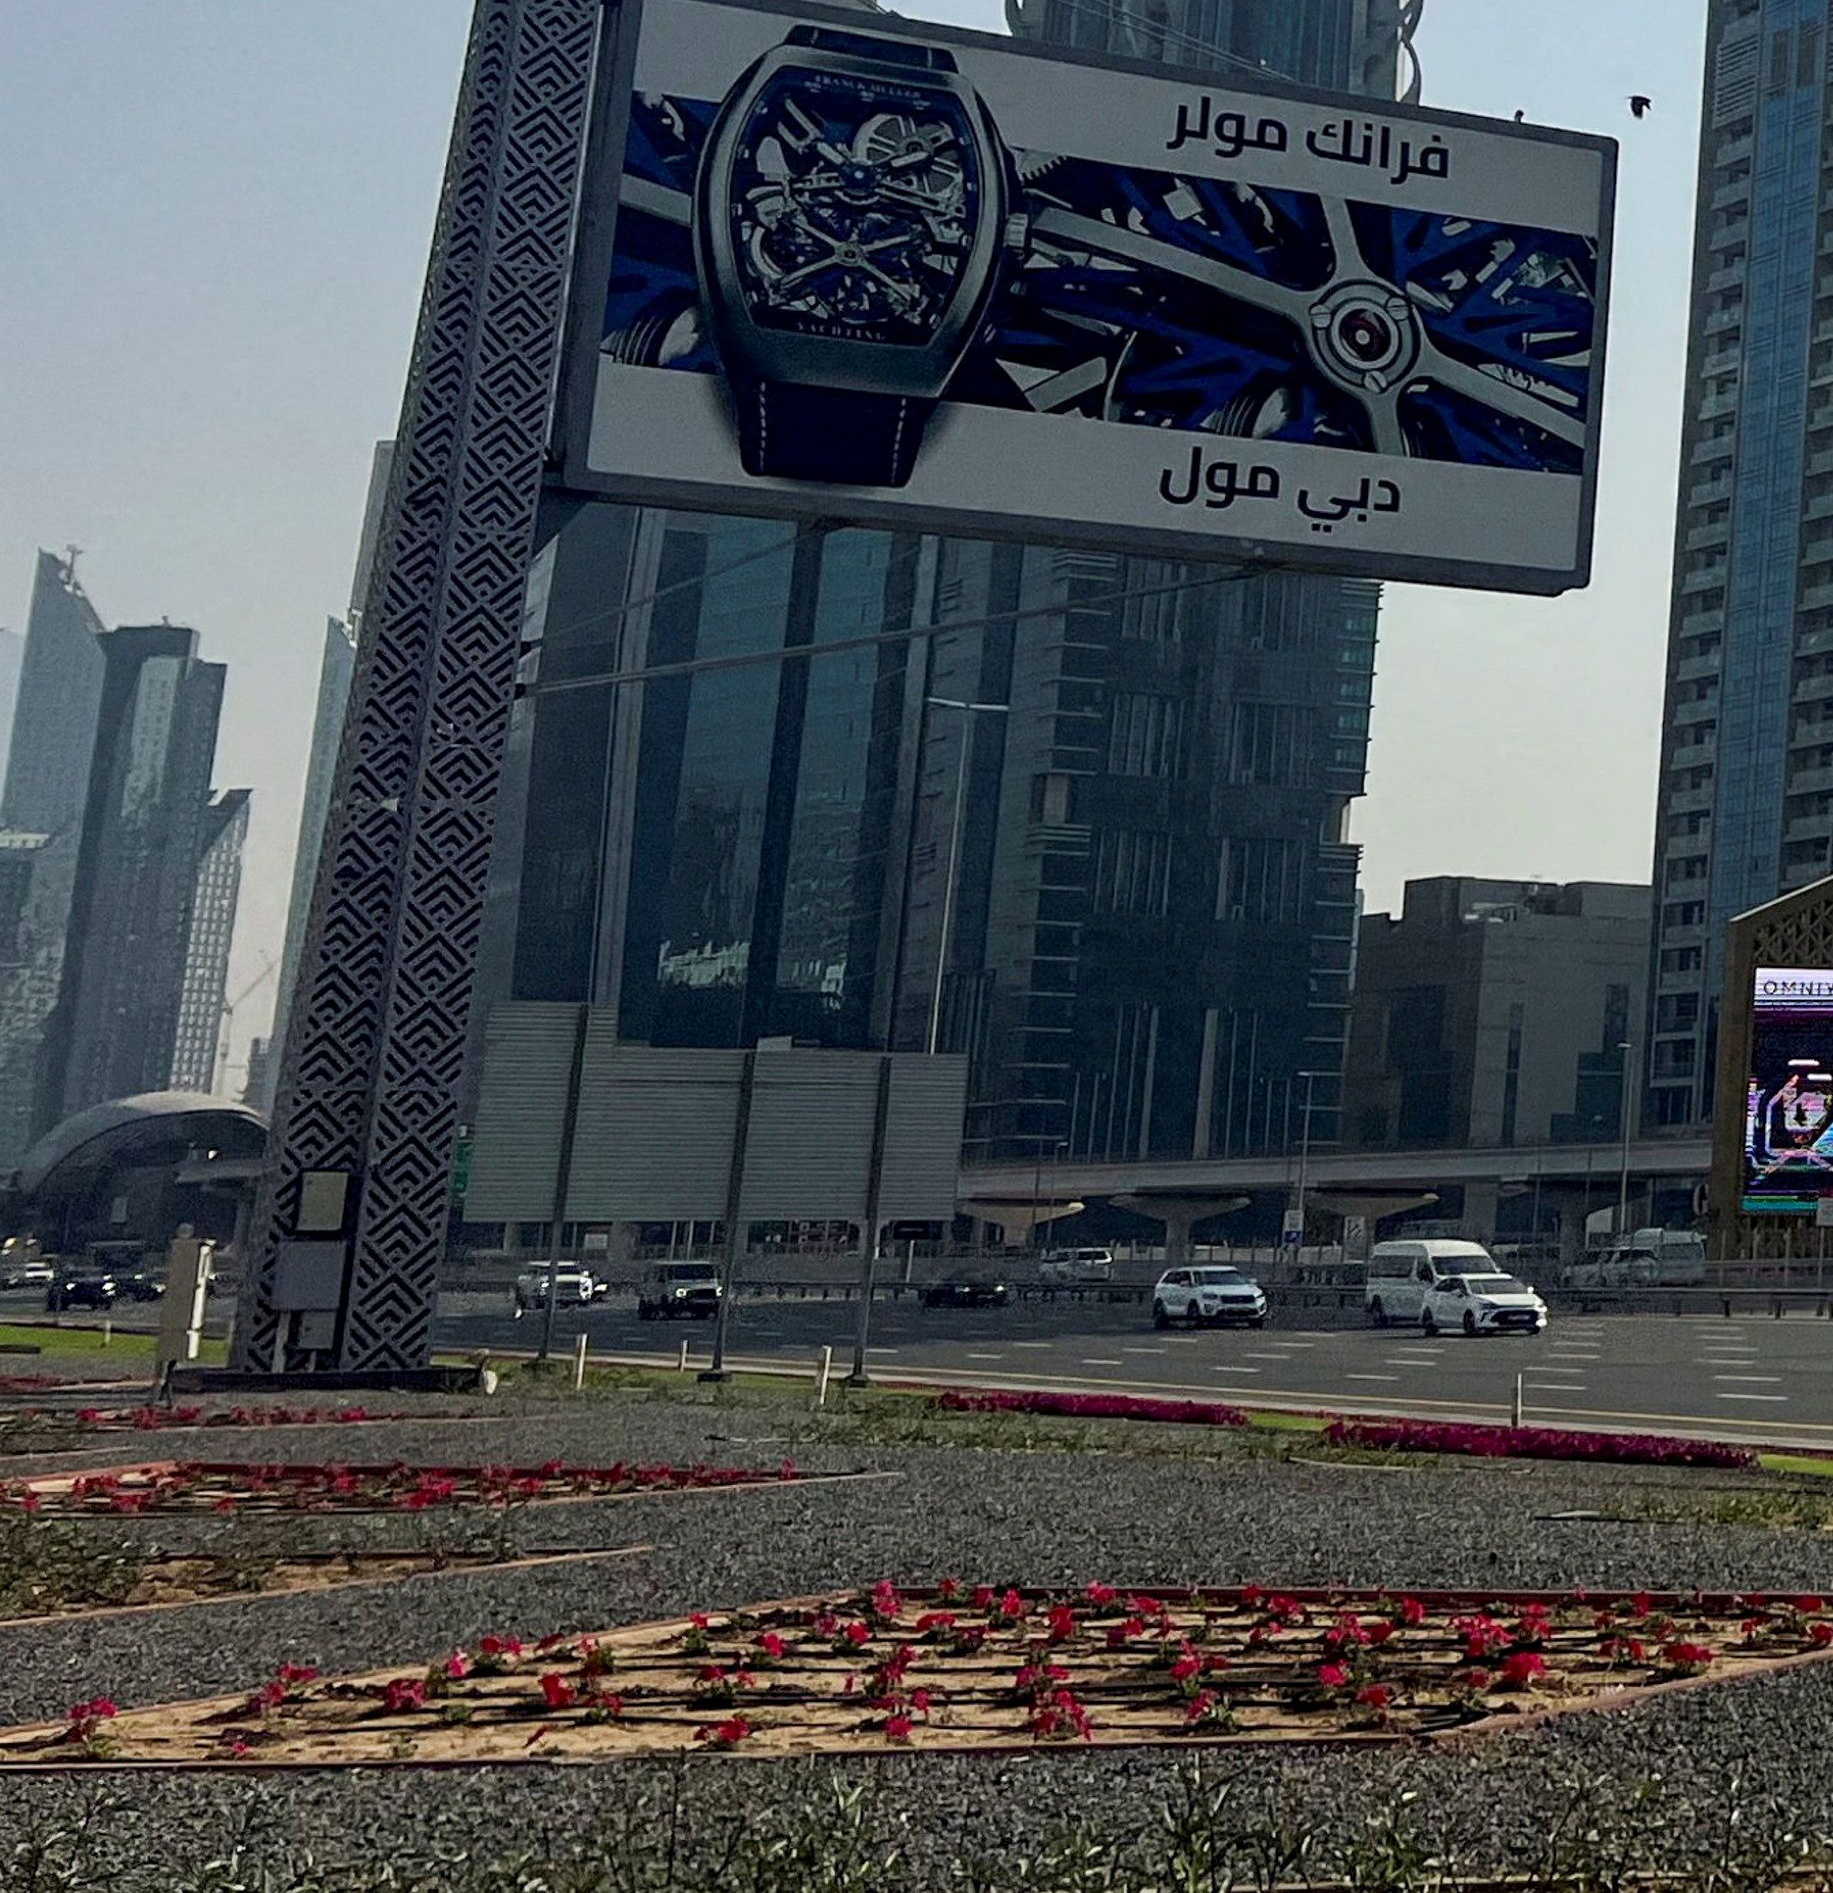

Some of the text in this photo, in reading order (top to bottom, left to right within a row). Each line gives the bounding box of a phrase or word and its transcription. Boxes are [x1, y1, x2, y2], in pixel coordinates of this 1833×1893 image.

[1166, 96, 1450, 185] فرانك مولر
[1159, 446, 1400, 533] دبي مول
